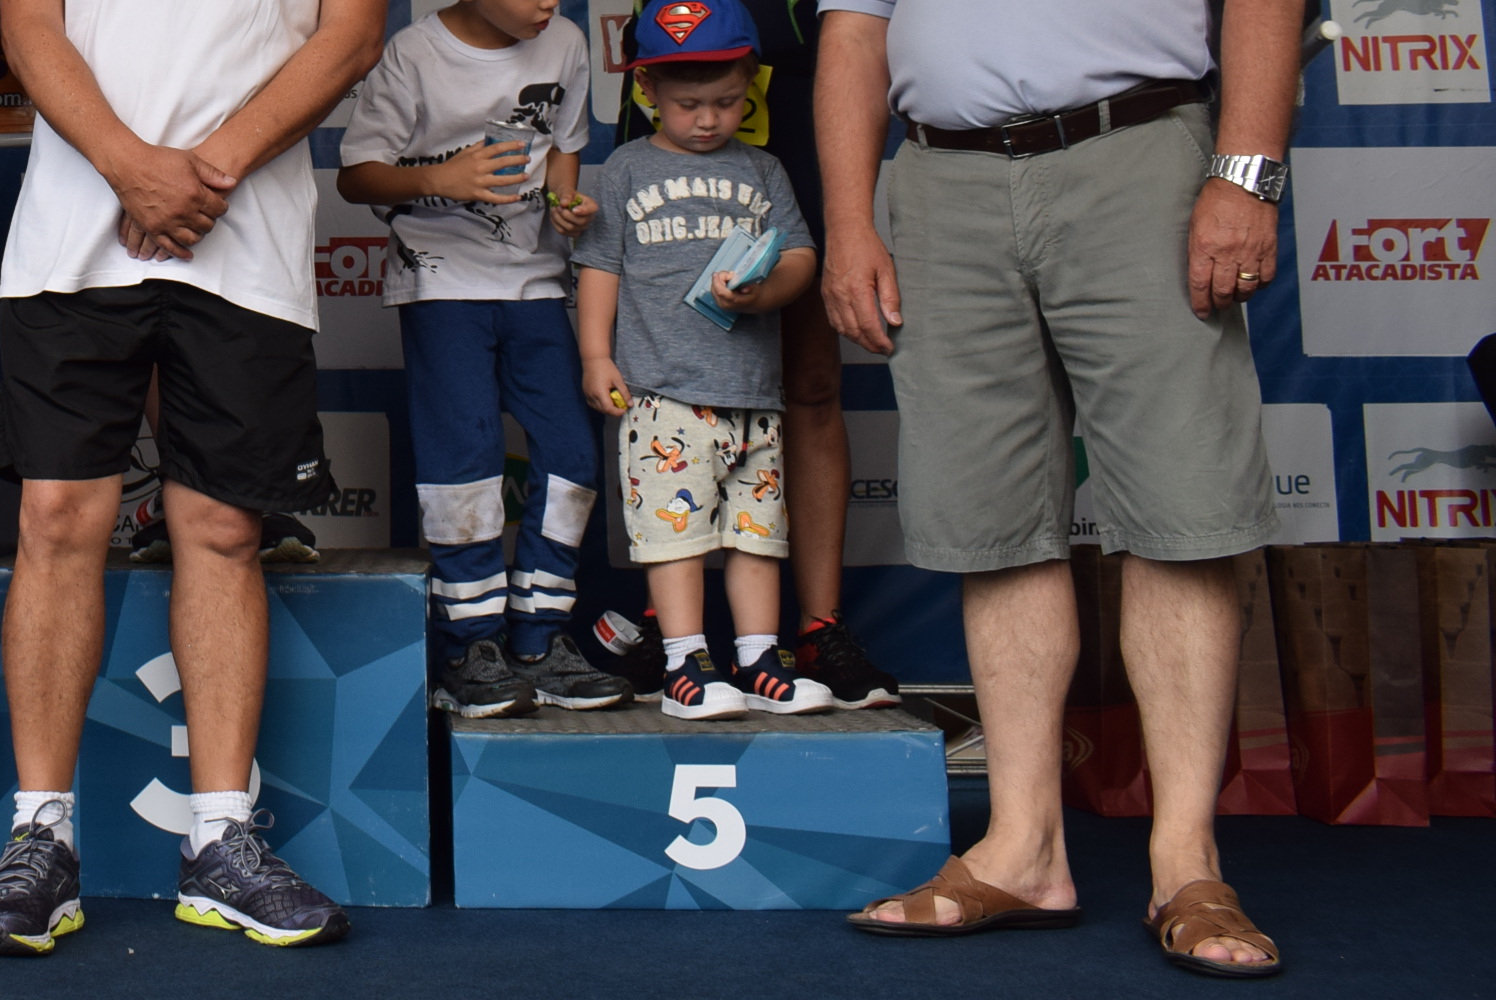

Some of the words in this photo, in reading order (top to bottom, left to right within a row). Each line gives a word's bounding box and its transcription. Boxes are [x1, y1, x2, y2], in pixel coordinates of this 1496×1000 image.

[1341, 34, 1481, 72] NITRIX
[626, 184, 665, 222] UM
[664, 176, 732, 200] MAIS
[1336, 218, 1479, 262] Fort
[1311, 263, 1480, 281] ATACADISTA
[664, 764, 747, 870] 5
